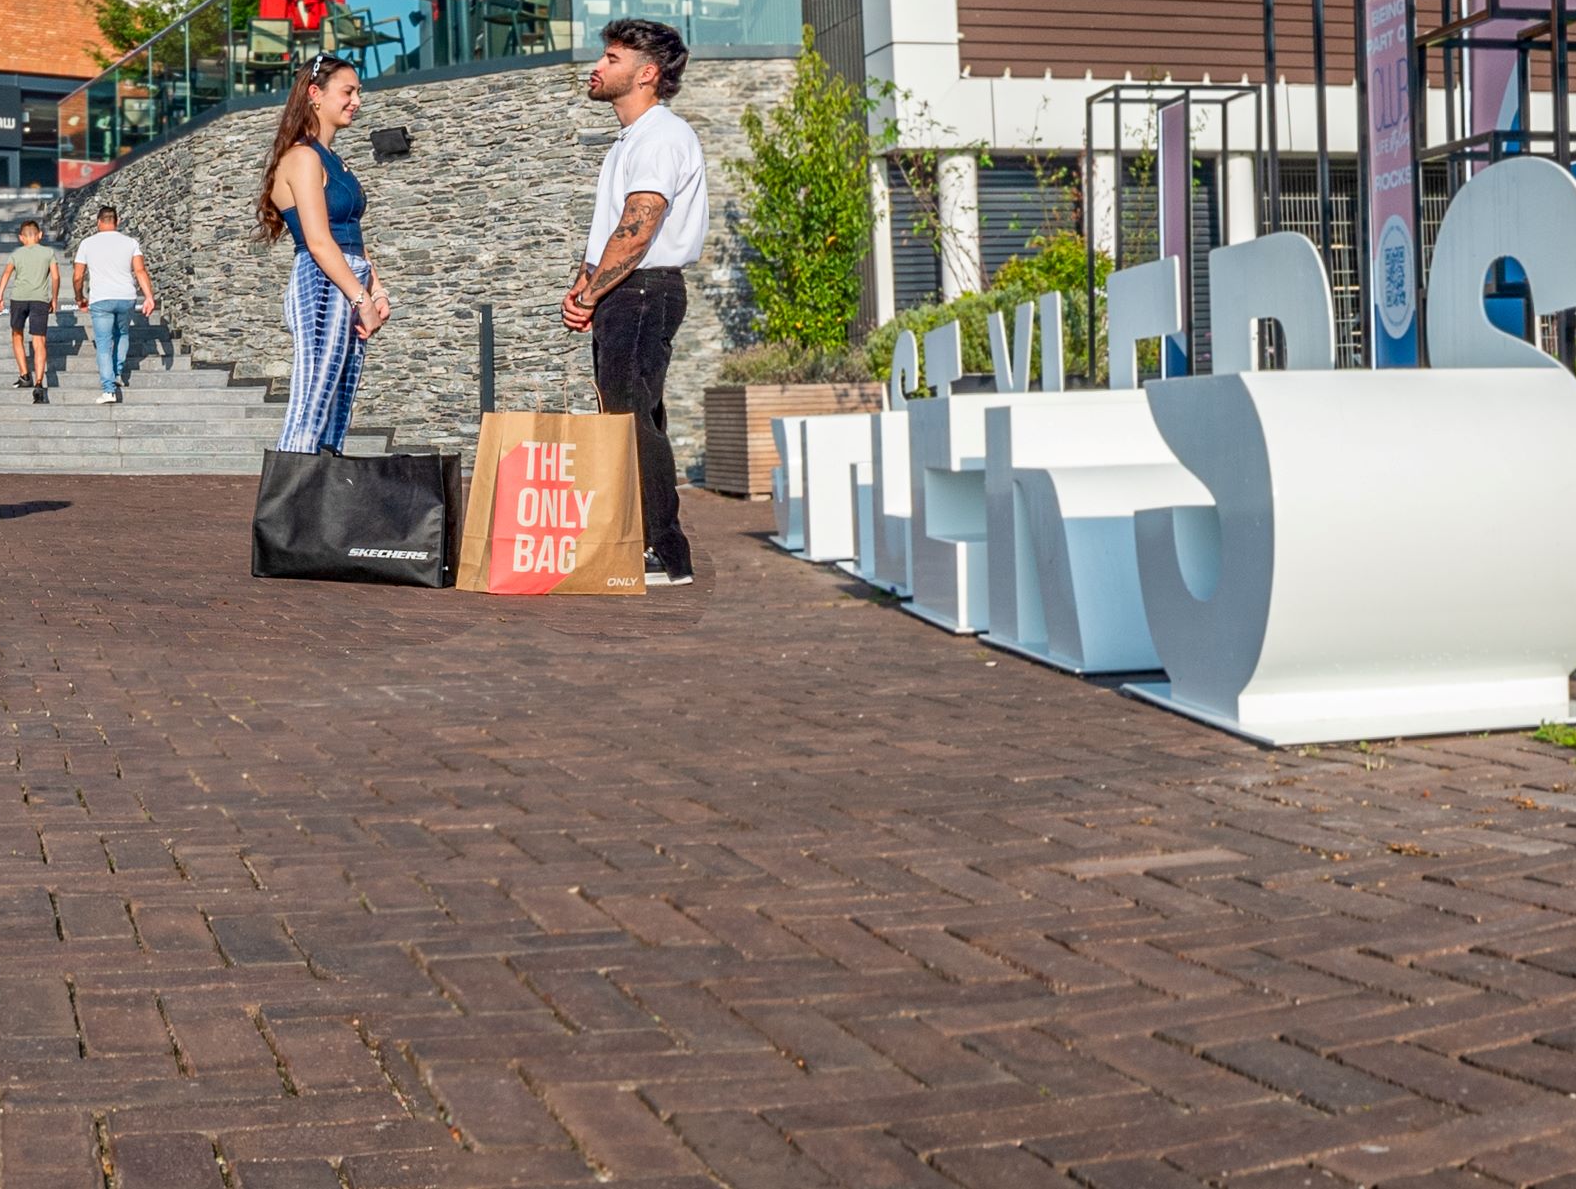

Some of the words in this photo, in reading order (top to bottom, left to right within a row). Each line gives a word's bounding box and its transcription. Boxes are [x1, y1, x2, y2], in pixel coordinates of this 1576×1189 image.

[1366, 29, 1394, 56] PART
[521, 441, 576, 482] THE
[516, 487, 596, 529] ONLY
[348, 547, 429, 560] SKECHERS
[513, 533, 576, 574] BAG
[607, 577, 638, 587] ONLY
